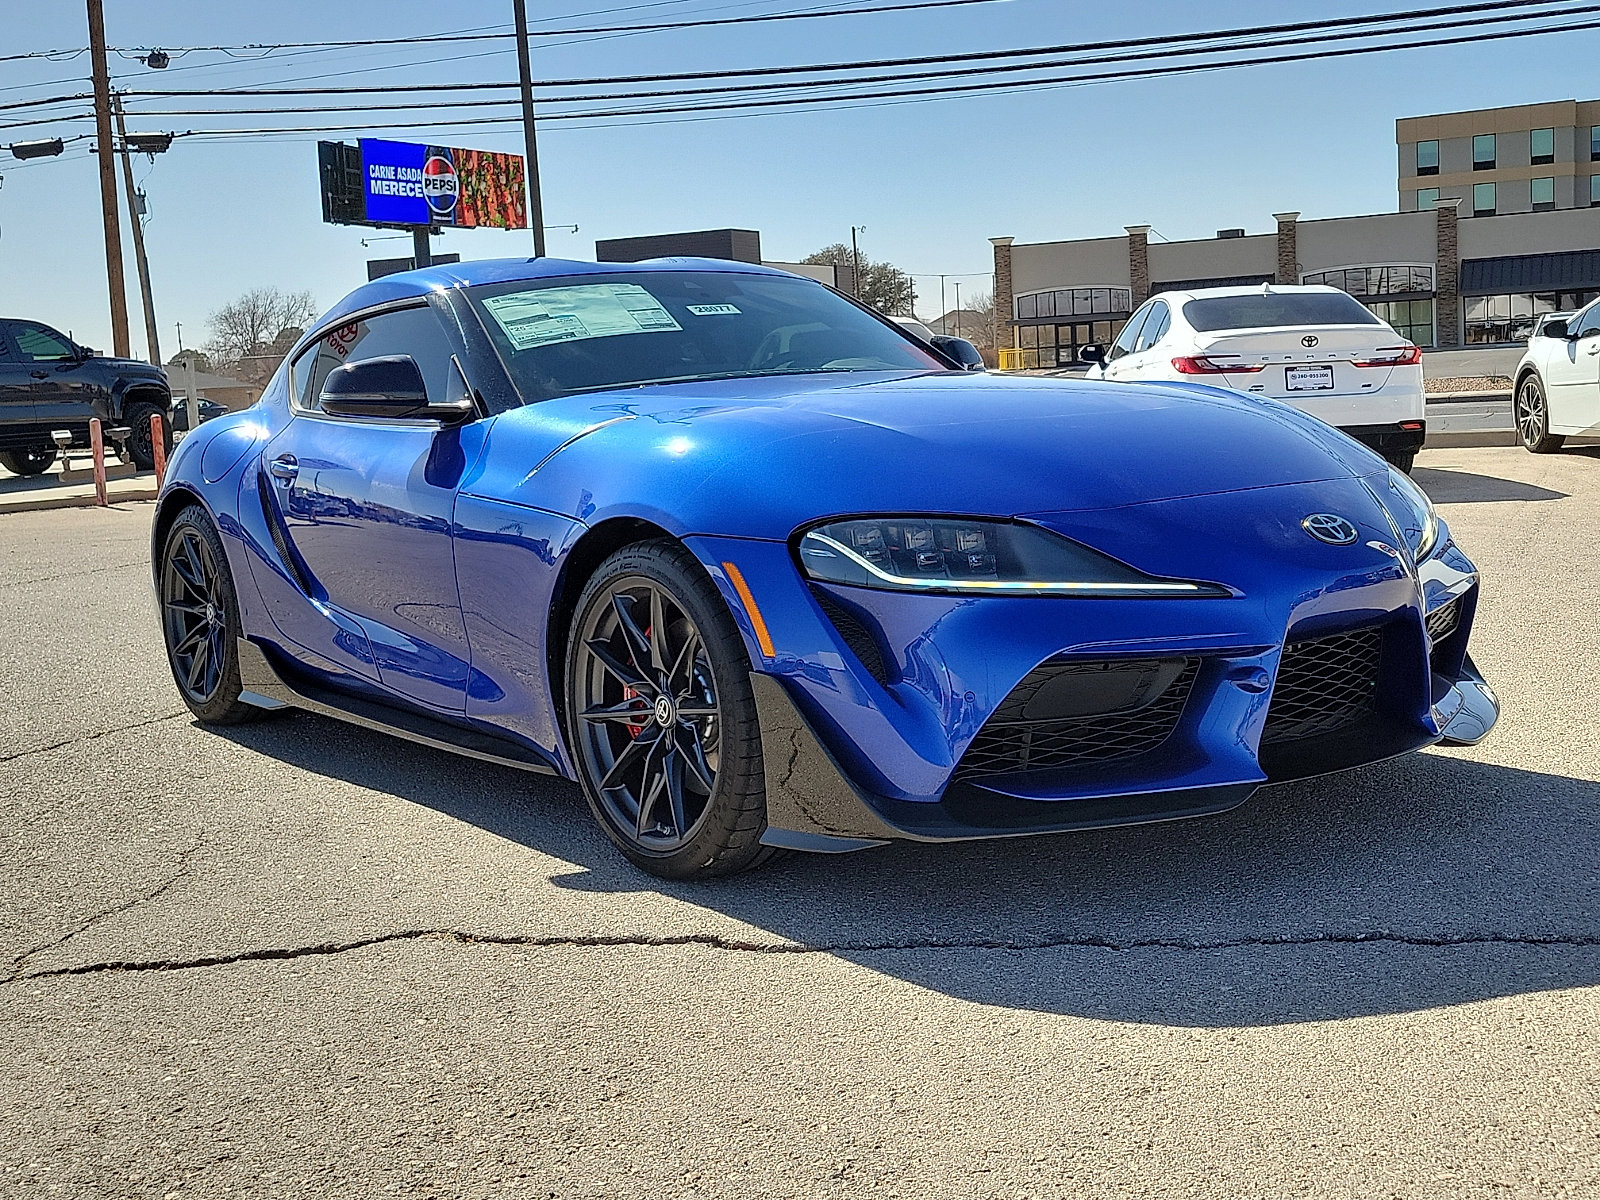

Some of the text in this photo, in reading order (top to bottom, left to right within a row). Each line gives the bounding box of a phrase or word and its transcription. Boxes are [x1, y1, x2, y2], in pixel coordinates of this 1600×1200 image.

[370, 165, 422, 182] CARNE ASADA
[370, 178, 456, 197] MERECE PEPSI
